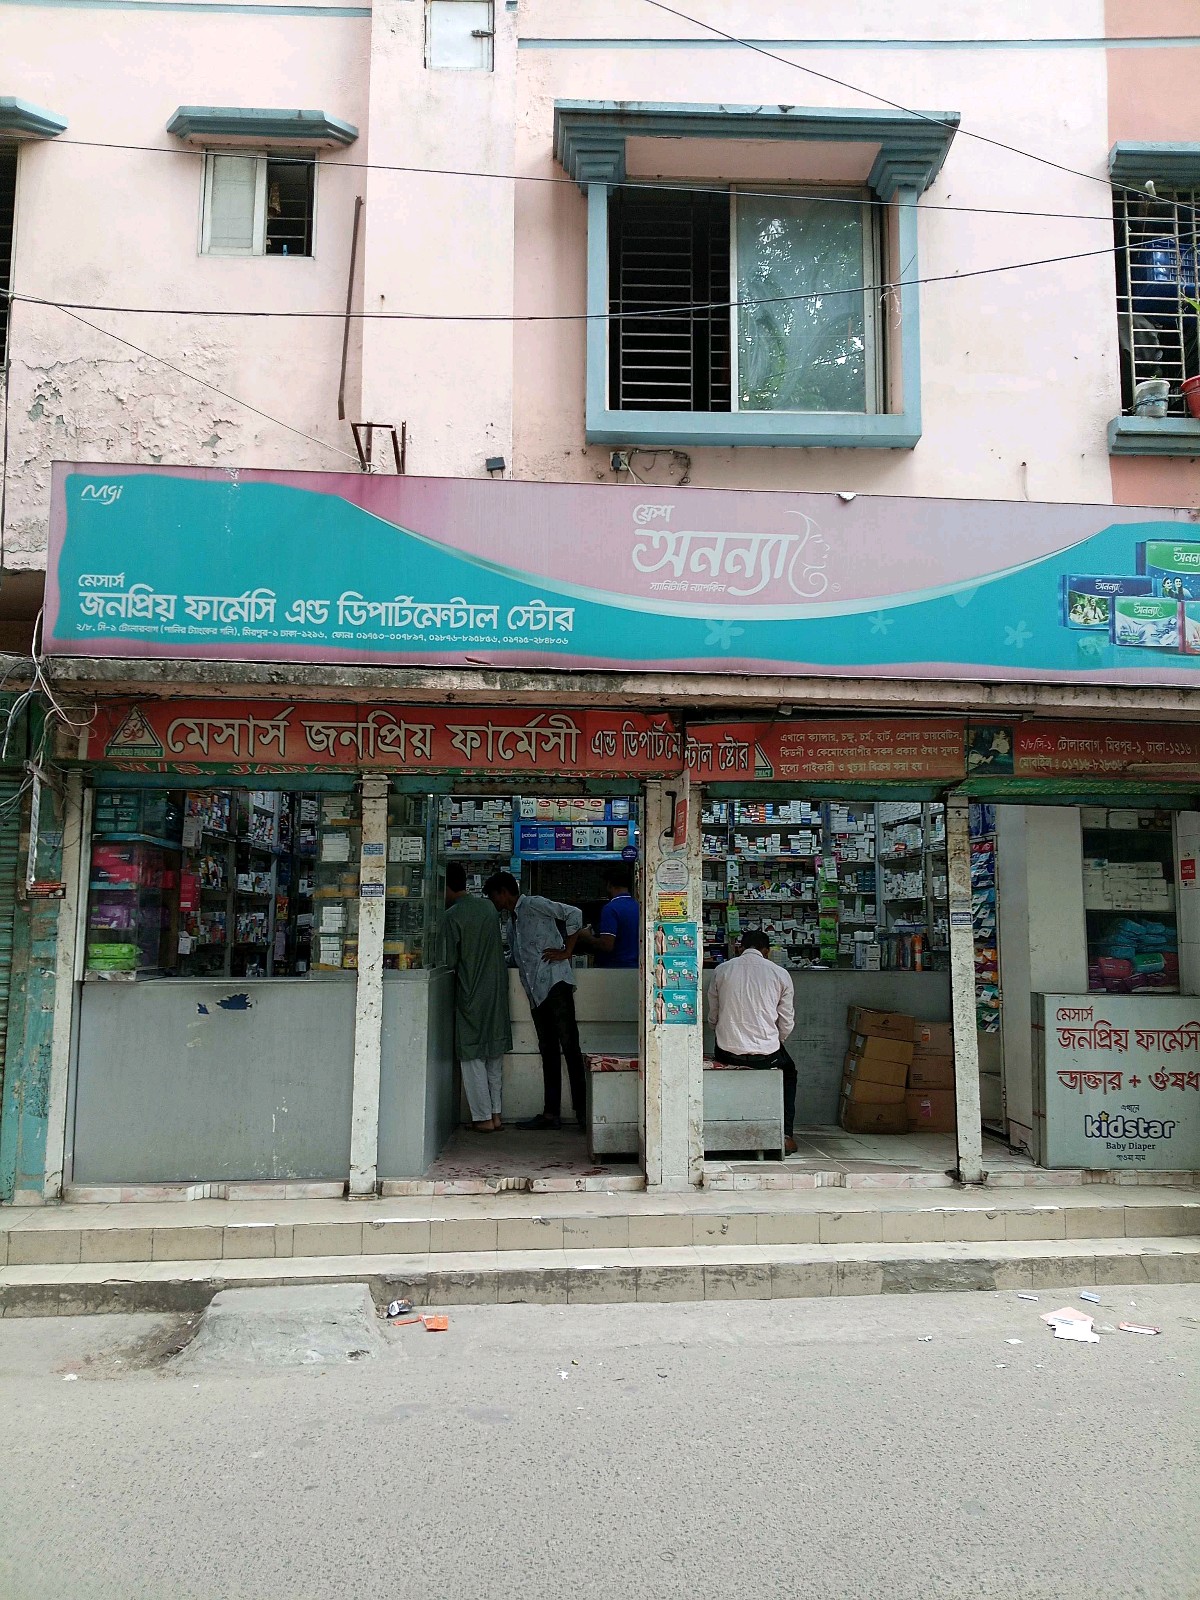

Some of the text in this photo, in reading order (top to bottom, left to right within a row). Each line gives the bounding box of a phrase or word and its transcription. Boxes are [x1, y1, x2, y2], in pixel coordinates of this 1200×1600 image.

[632, 503, 675, 524] ফ্রেশ
[631, 528, 800, 596] অনন্যা
[78, 572, 125, 588] মেসার্স
[79, 583, 178, 622] জনপ্রিয়
[183, 588, 277, 623] ফার্মেসি
[337, 591, 499, 629] ডিপার্টমেন্টাল
[507, 599, 575, 632] স্টোর
[166, 705, 296, 757] মেসার্স
[300, 709, 436, 762] জনপ্রিয়
[445, 713, 582, 763] ফার্মেসী
[1056, 1006, 1093, 1022] মেসার্স
[1056, 1020, 1129, 1053] জনপ্রিয়
[1057, 1071, 1123, 1095] ডাক্তার
[1149, 1066, 1200, 1092] ঔষধ
[1085, 1112, 1175, 1138] kidstar
[1106, 1142, 1156, 1151] Baby Diaper
